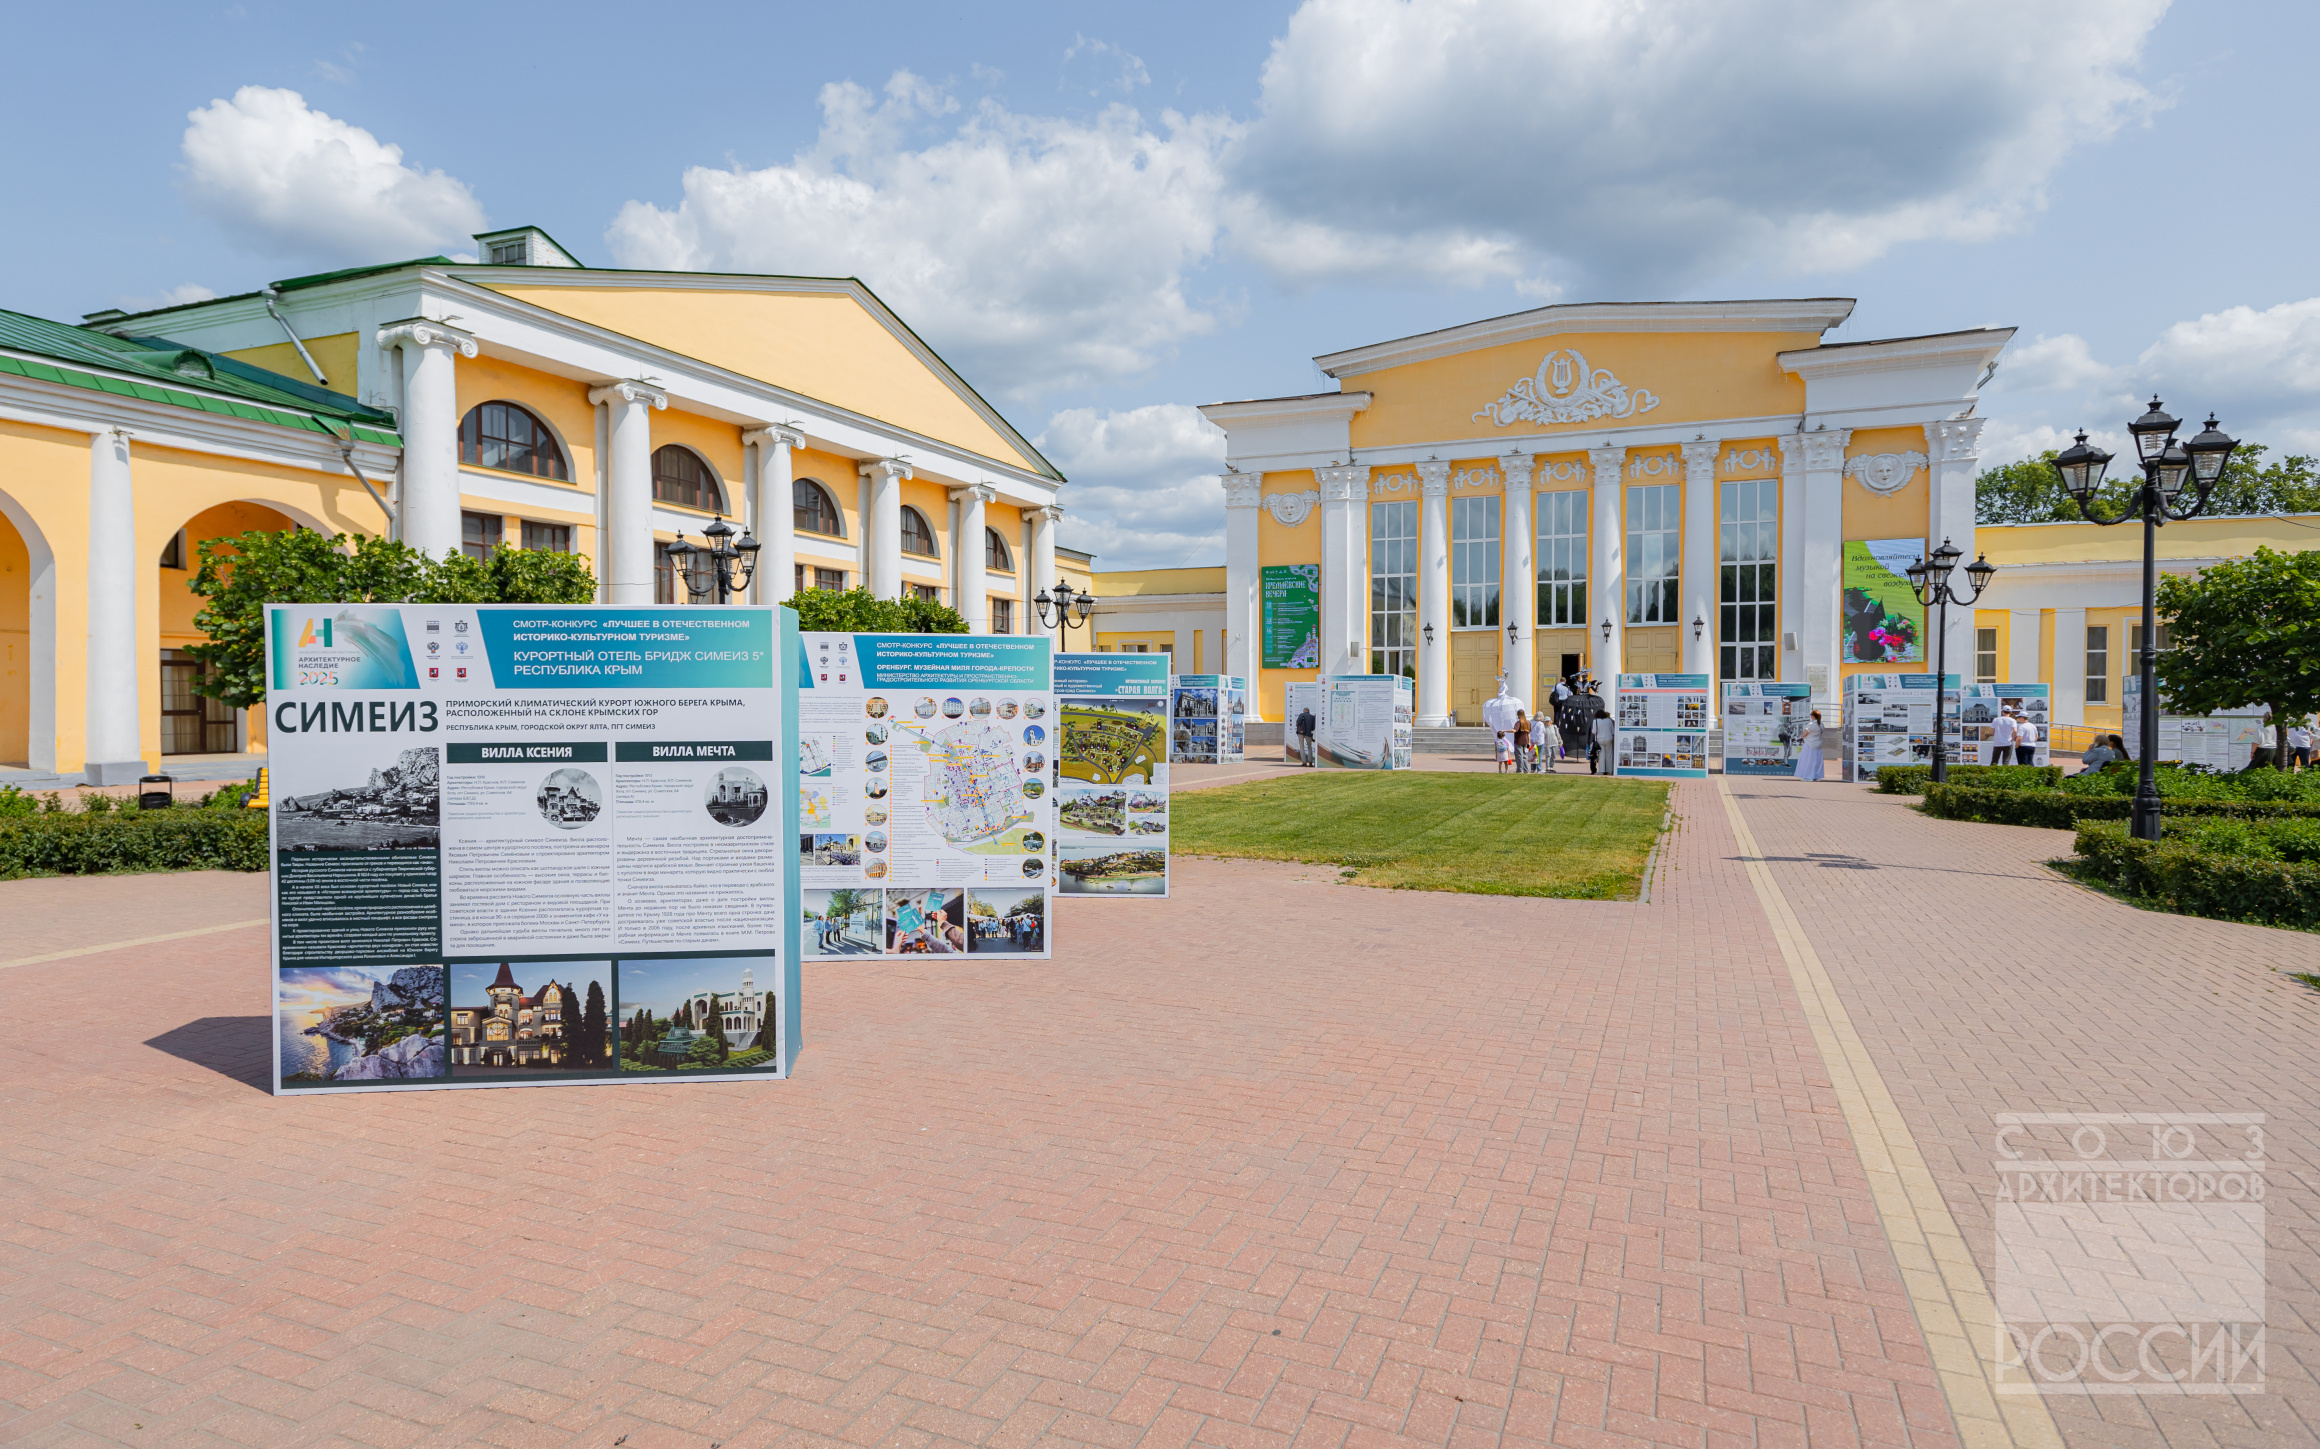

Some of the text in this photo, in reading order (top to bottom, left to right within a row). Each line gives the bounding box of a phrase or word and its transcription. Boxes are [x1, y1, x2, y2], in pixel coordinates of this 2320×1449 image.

[514, 650, 594, 661] КУРОРТНЫЙ
[598, 651, 641, 661] ОТЕЛЬ
[645, 651, 692, 663] БРИДЖ
[695, 651, 749, 661] СИМЕИЗ
[514, 665, 642, 675] РЕСПУБЛИКА КРЫМ
[299, 671, 338, 685] 2025
[1115, 686, 1165, 694] «СТАРАЯ ВОЛГА»
[446, 699, 511, 708] ПРИМОРСКИЙ
[514, 699, 596, 707] КЛИМАТИЧЕСКИЙ
[710, 700, 745, 708] КРЫМА,
[275, 701, 438, 733] СИМЕИЗ
[446, 708, 532, 717] РАСПОЛОЖЕННЫЙ
[481, 747, 572, 758] ВИЛЛА КСЕНИЯ
[653, 746, 736, 756] ВИЛЛА МЕЧТА
